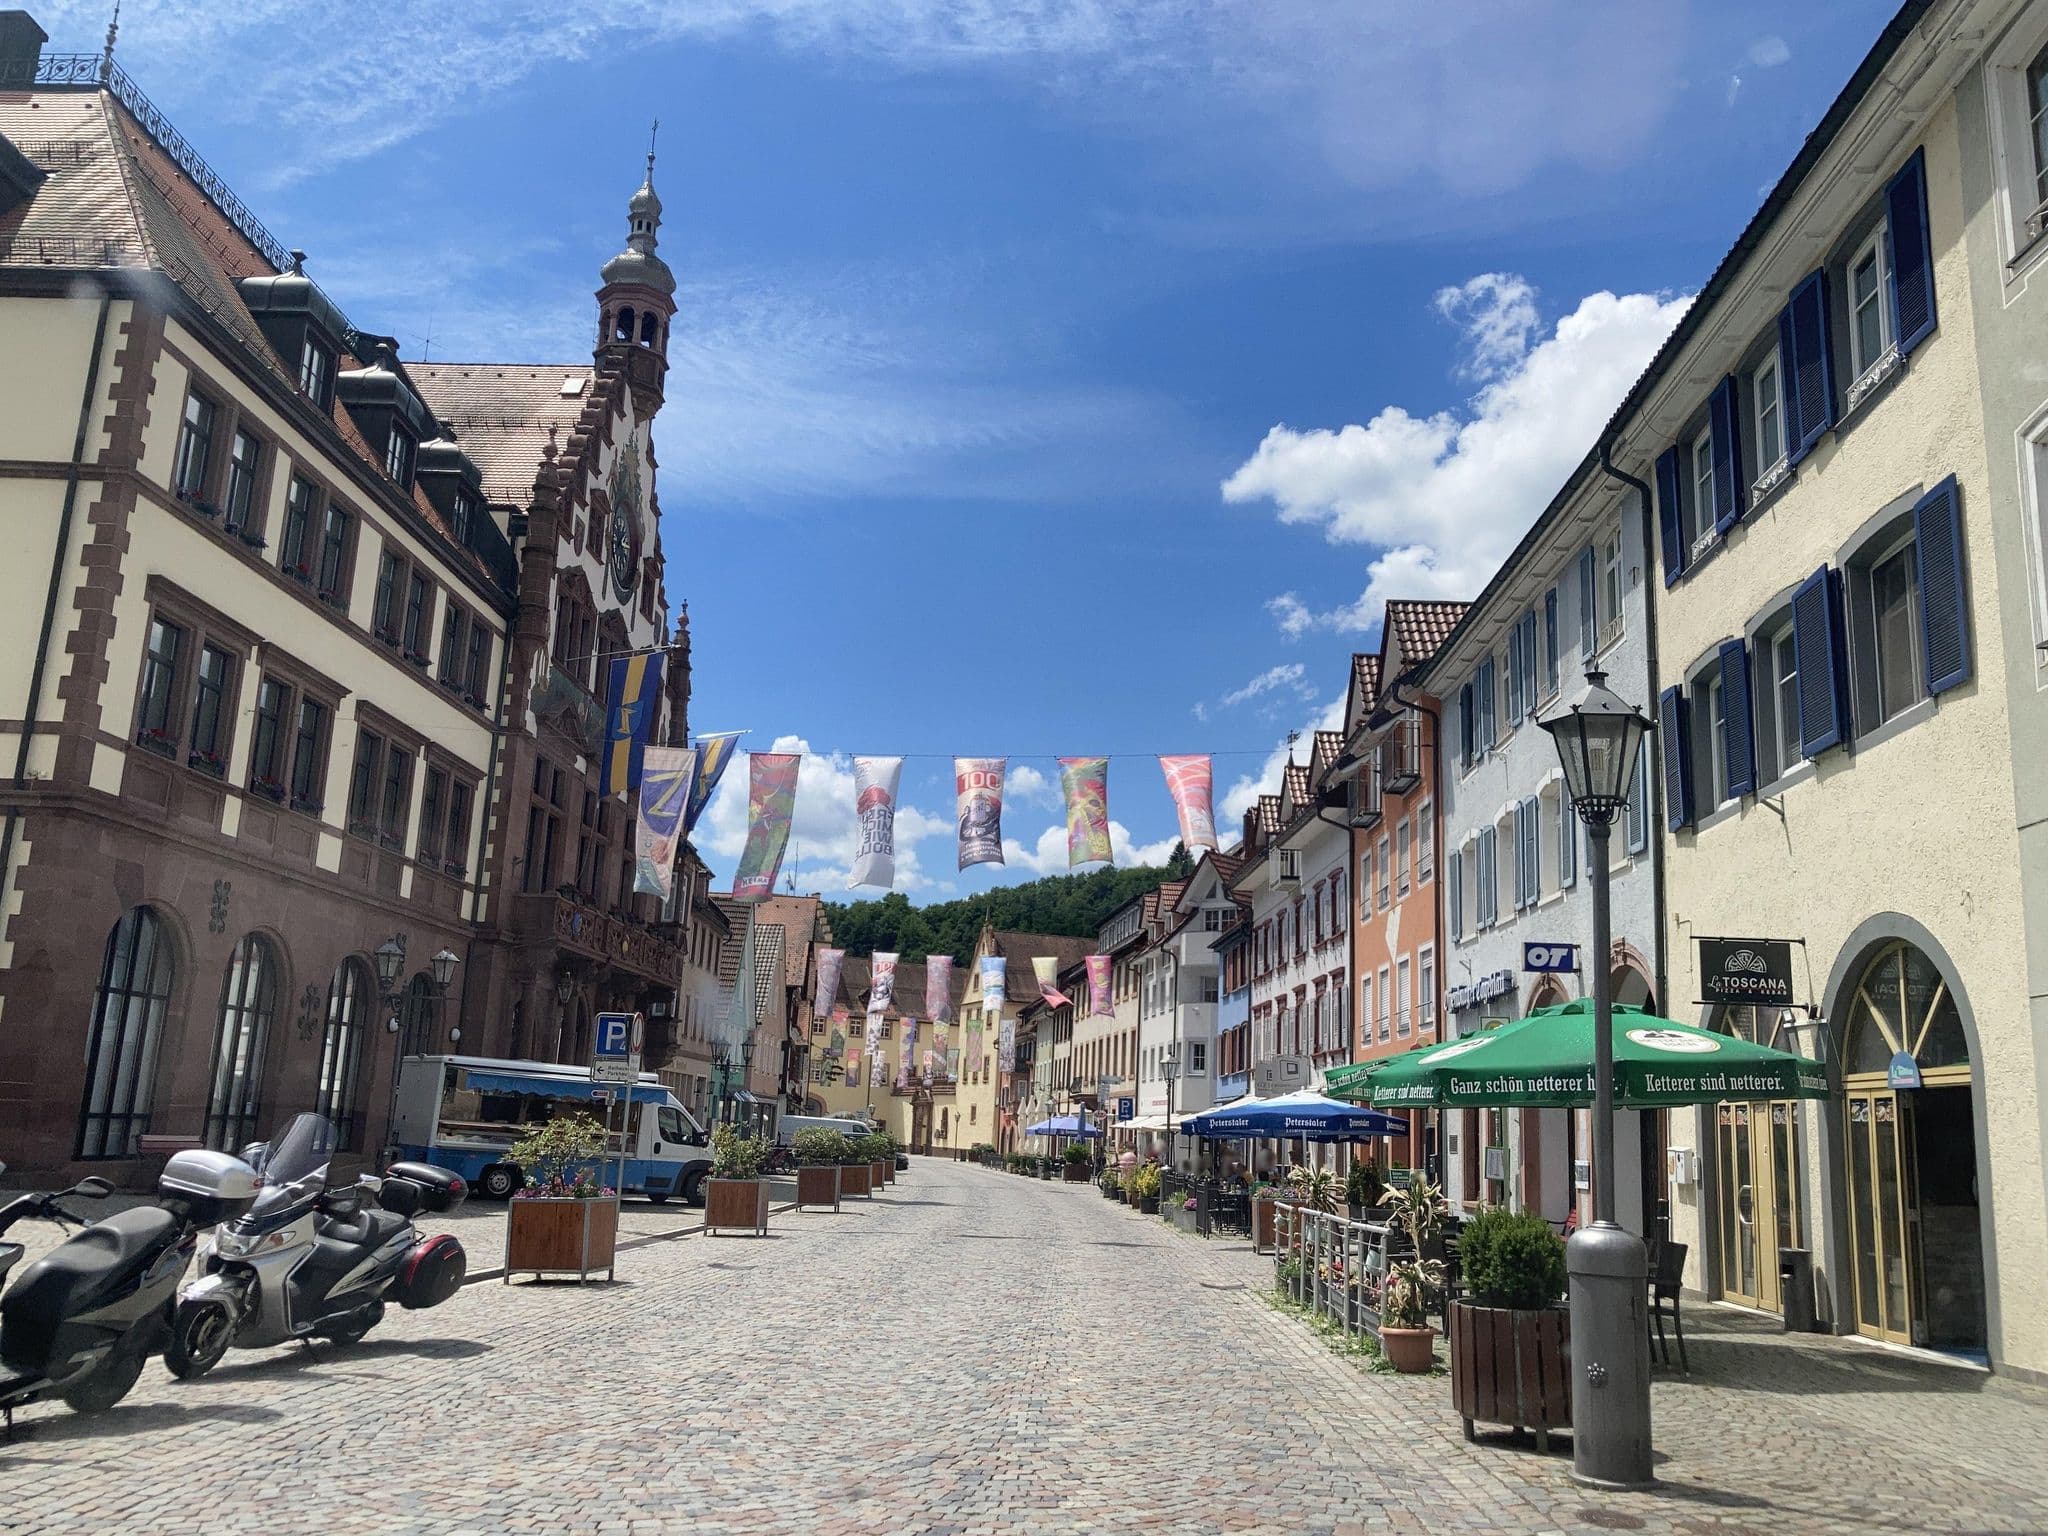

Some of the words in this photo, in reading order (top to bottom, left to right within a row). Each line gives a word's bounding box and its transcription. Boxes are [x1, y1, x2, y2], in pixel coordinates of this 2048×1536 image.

[962, 771, 1002, 791] 100
[1527, 947, 1569, 967] OT
[1722, 976, 1787, 990] TOSCANA
[605, 1021, 627, 1051] P
[1374, 1085, 1397, 1100] Ketterer
[1398, 1082, 1409, 1099] sind
[1409, 1084, 1434, 1099] netterer.
[1451, 1077, 1482, 1094] Ganz
[1486, 1076, 1523, 1092] schön
[1527, 1075, 1583, 1092] netterer
[1645, 1073, 1696, 1092] Ketterer
[1700, 1072, 1727, 1091] sind
[1730, 1073, 1785, 1091] netterer.
[1121, 1100, 1130, 1113] P
[1209, 1118, 1250, 1129] Peterstaler
[1285, 1117, 1327, 1129] Peterstaler
